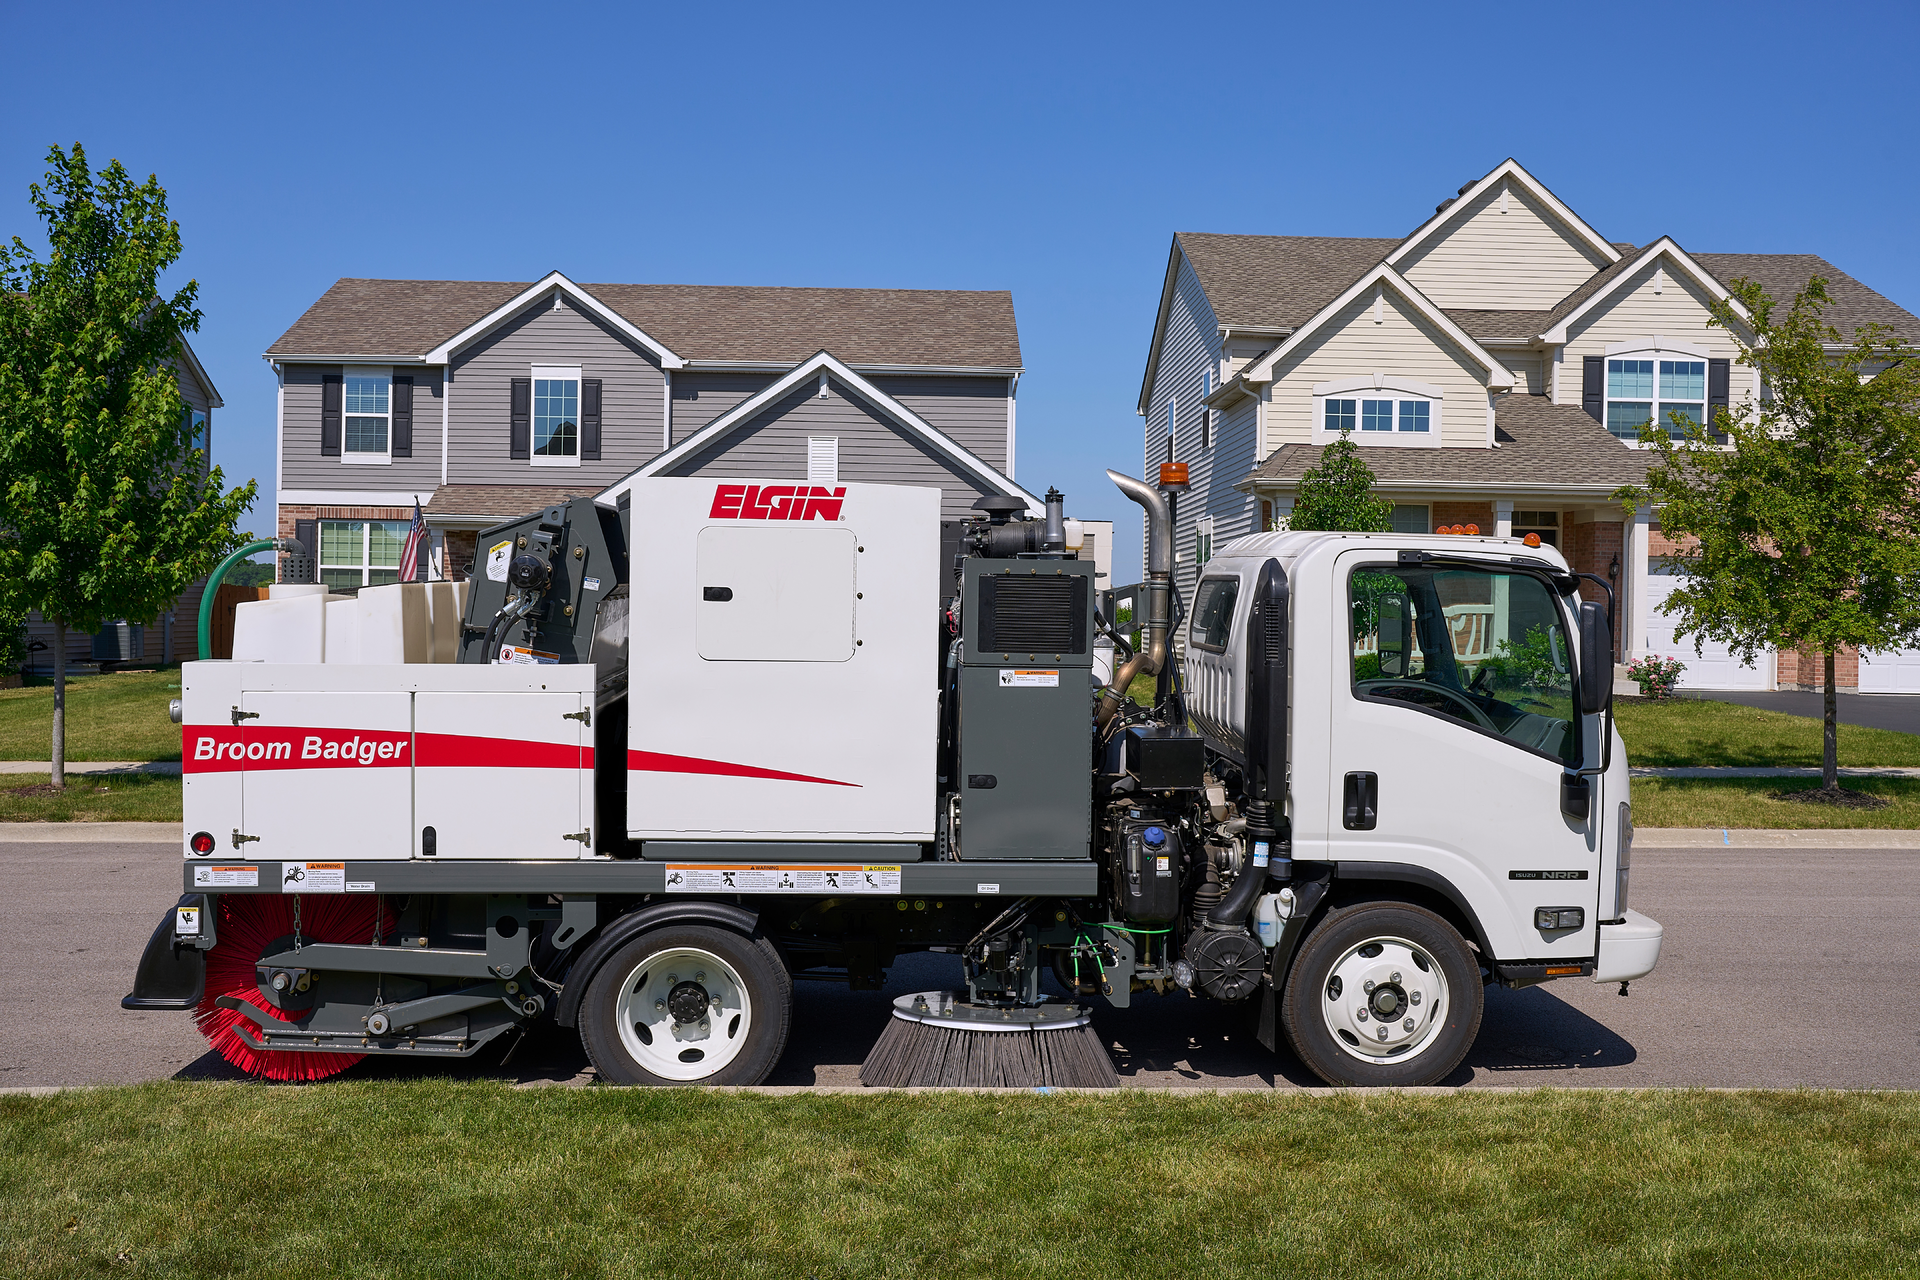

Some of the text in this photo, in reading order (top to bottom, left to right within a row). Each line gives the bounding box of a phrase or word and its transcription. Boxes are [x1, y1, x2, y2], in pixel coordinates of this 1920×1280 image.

[708, 484, 847, 521] ELGIN
[194, 736, 408, 765] Broom Badger
